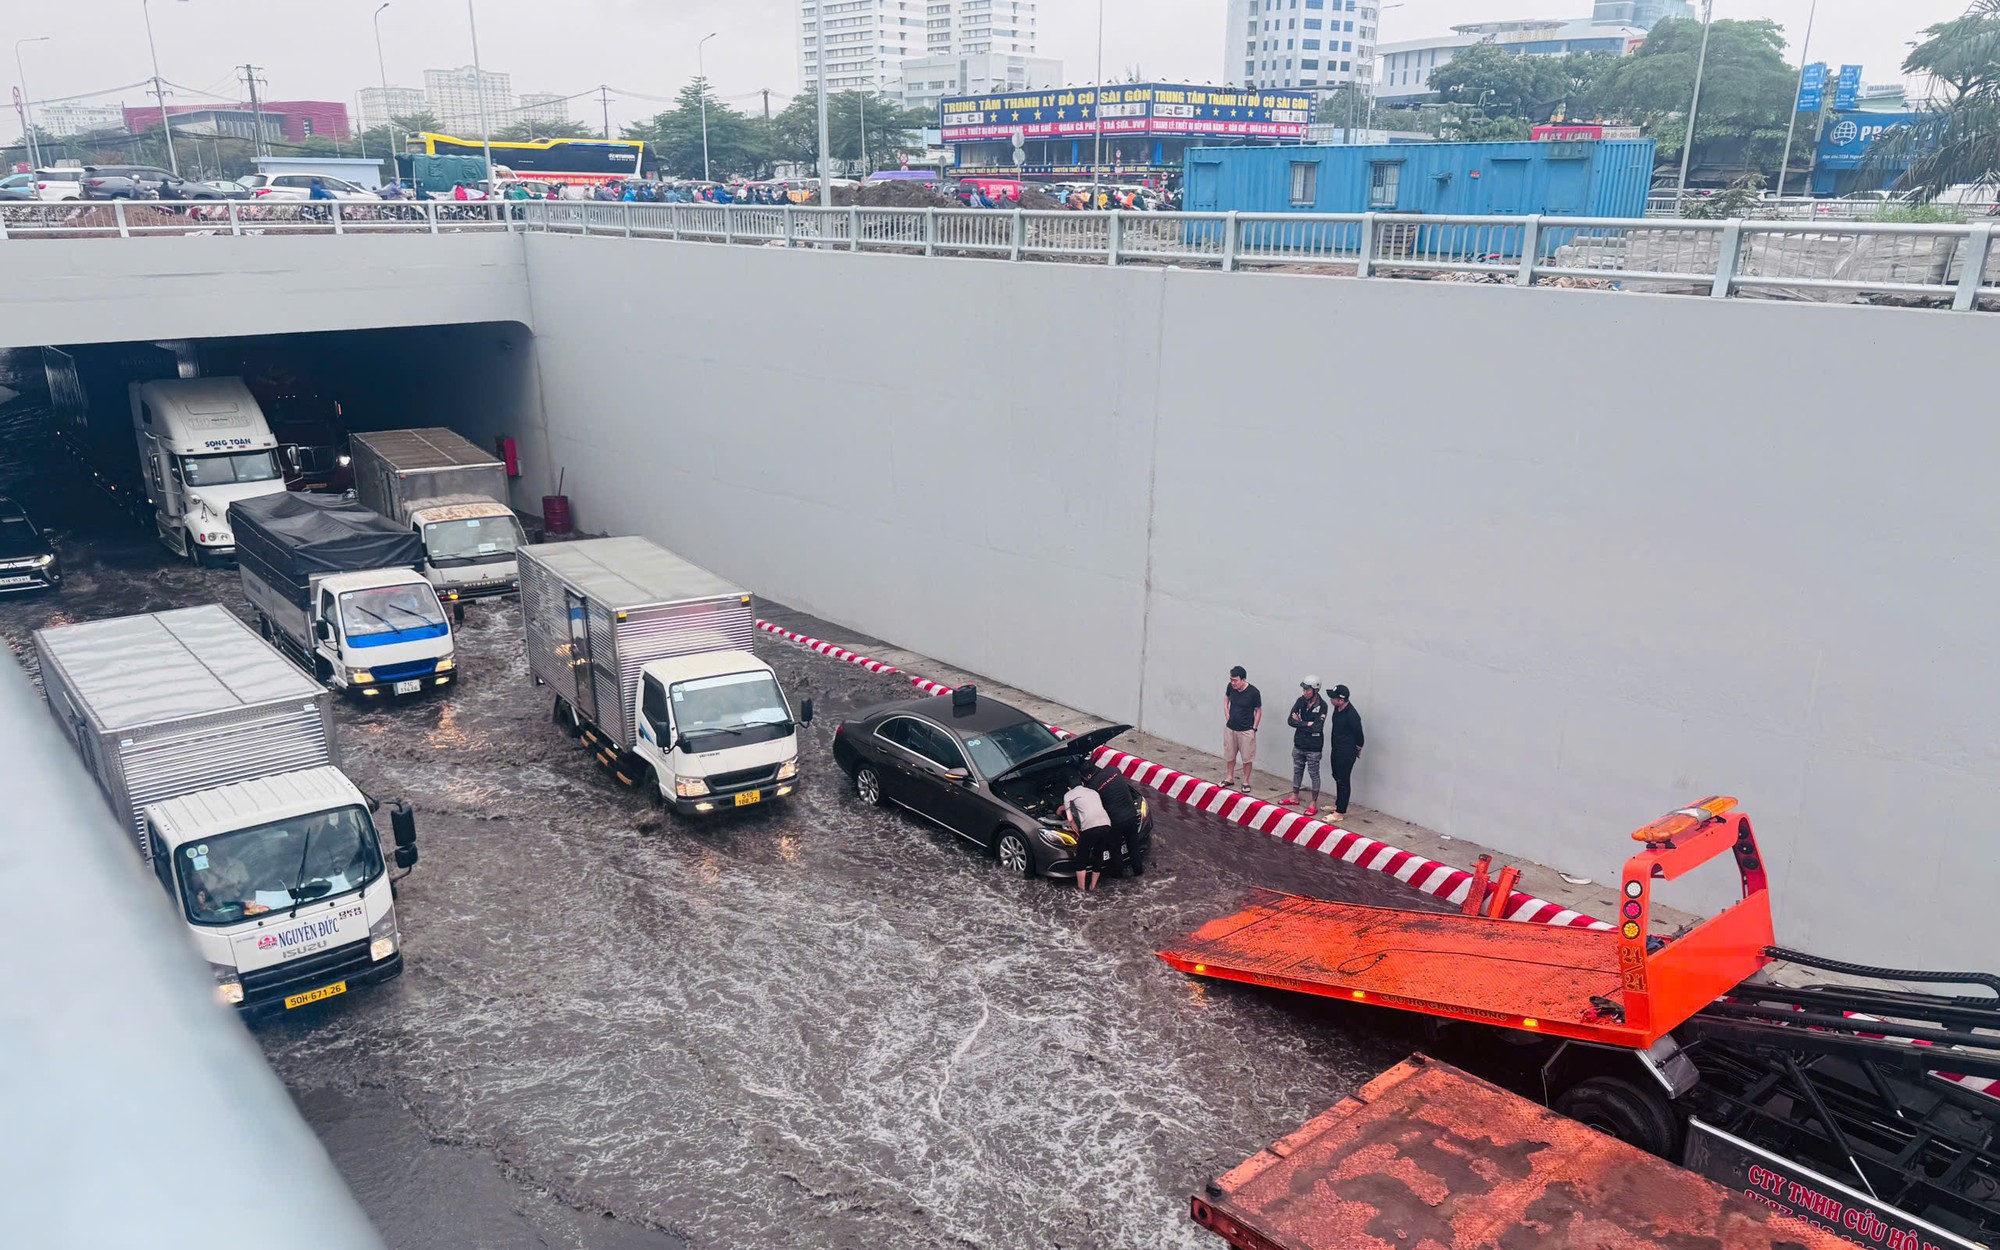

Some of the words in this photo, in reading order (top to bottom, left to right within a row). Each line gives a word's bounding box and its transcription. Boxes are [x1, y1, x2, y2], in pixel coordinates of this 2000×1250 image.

[943, 101, 976, 113] TRUNG
[979, 98, 1001, 110] TÂM
[1003, 97, 1040, 109] THANH
[1042, 94, 1056, 107] LÝ
[1058, 91, 1075, 106] ĐỒ
[1100, 90, 1121, 103] SÀI
[1124, 88, 1151, 102] GÒN
[1155, 90, 1184, 103] TRUNG
[1187, 91, 1206, 104] TÂM
[1208, 93, 1236, 106] THANH
[1238, 92, 1248, 107] LÝ
[1276, 96, 1290, 109] SÀI
[1292, 96, 1309, 110] GÒN
[283, 940, 327, 958] ISUZU
[1622, 946, 1643, 964] 24
[1625, 973, 1646, 991] 24
[1748, 1165, 1787, 1195] CTY
[1788, 1181, 1843, 1222] TNHH
